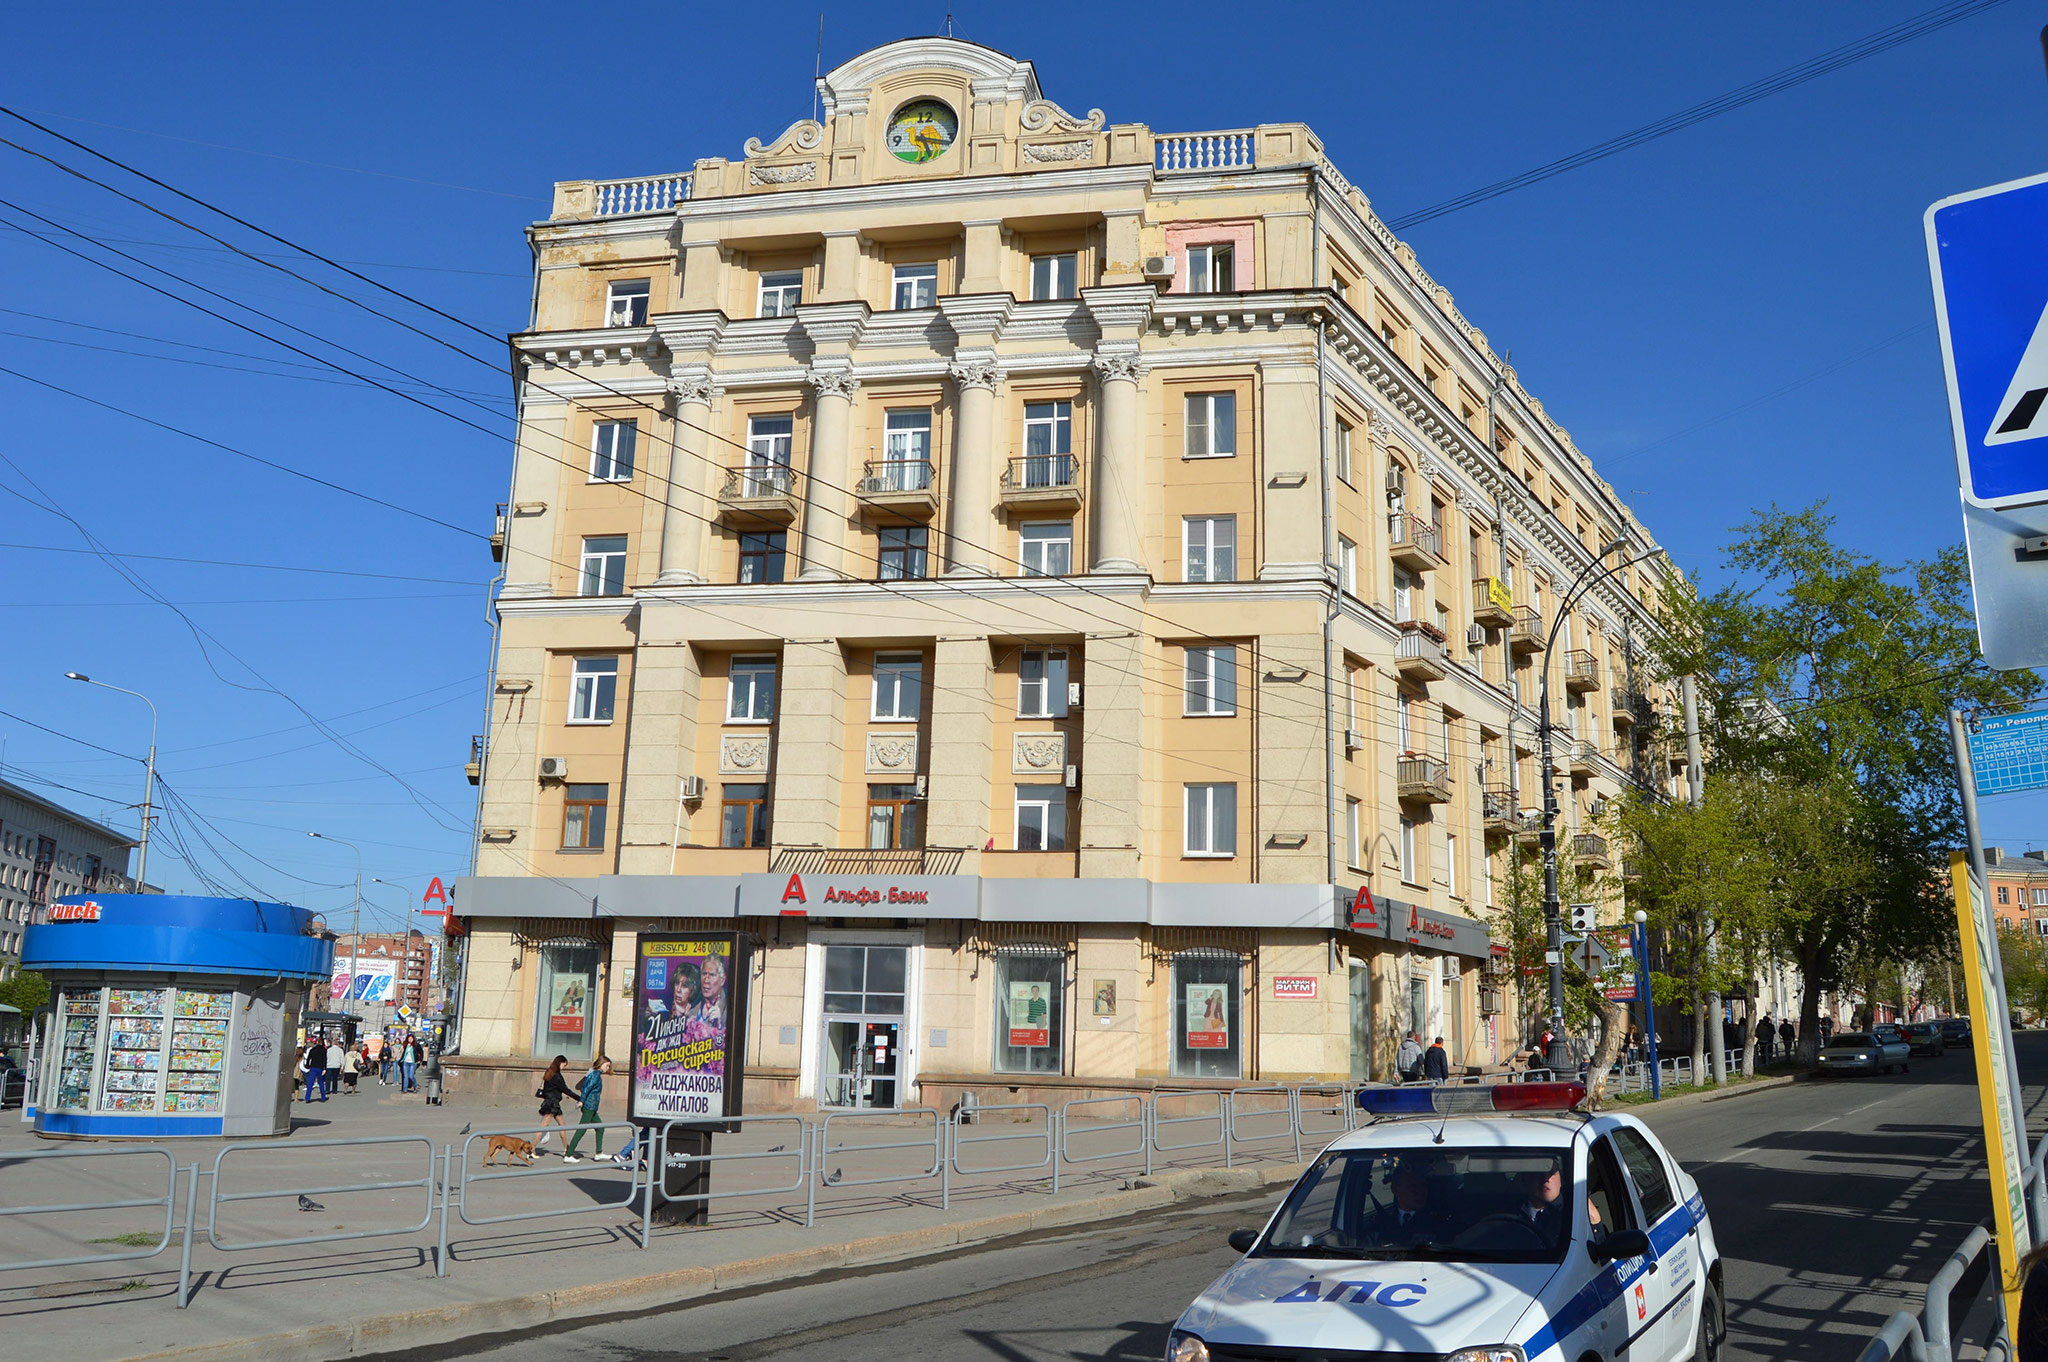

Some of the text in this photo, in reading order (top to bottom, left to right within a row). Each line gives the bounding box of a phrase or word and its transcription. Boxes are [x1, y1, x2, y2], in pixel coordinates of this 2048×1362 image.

[917, 111, 933, 124] 12
[892, 135, 902, 147] 9
[650, 940, 725, 953] kassy.ru 246 0000
[649, 960, 666, 968] РАДИО
[650, 968, 664, 976] ДАЧА
[1275, 984, 1311, 992] РИТМ
[646, 1014, 662, 1041] 21
[641, 1038, 713, 1069] Персидская
[683, 1049, 726, 1071] сирень
[651, 1073, 722, 1094] АХЕДЖАКОВА
[657, 1094, 709, 1114] ЖИГАЛОВ
[1272, 1280, 1428, 1308] ДПС
